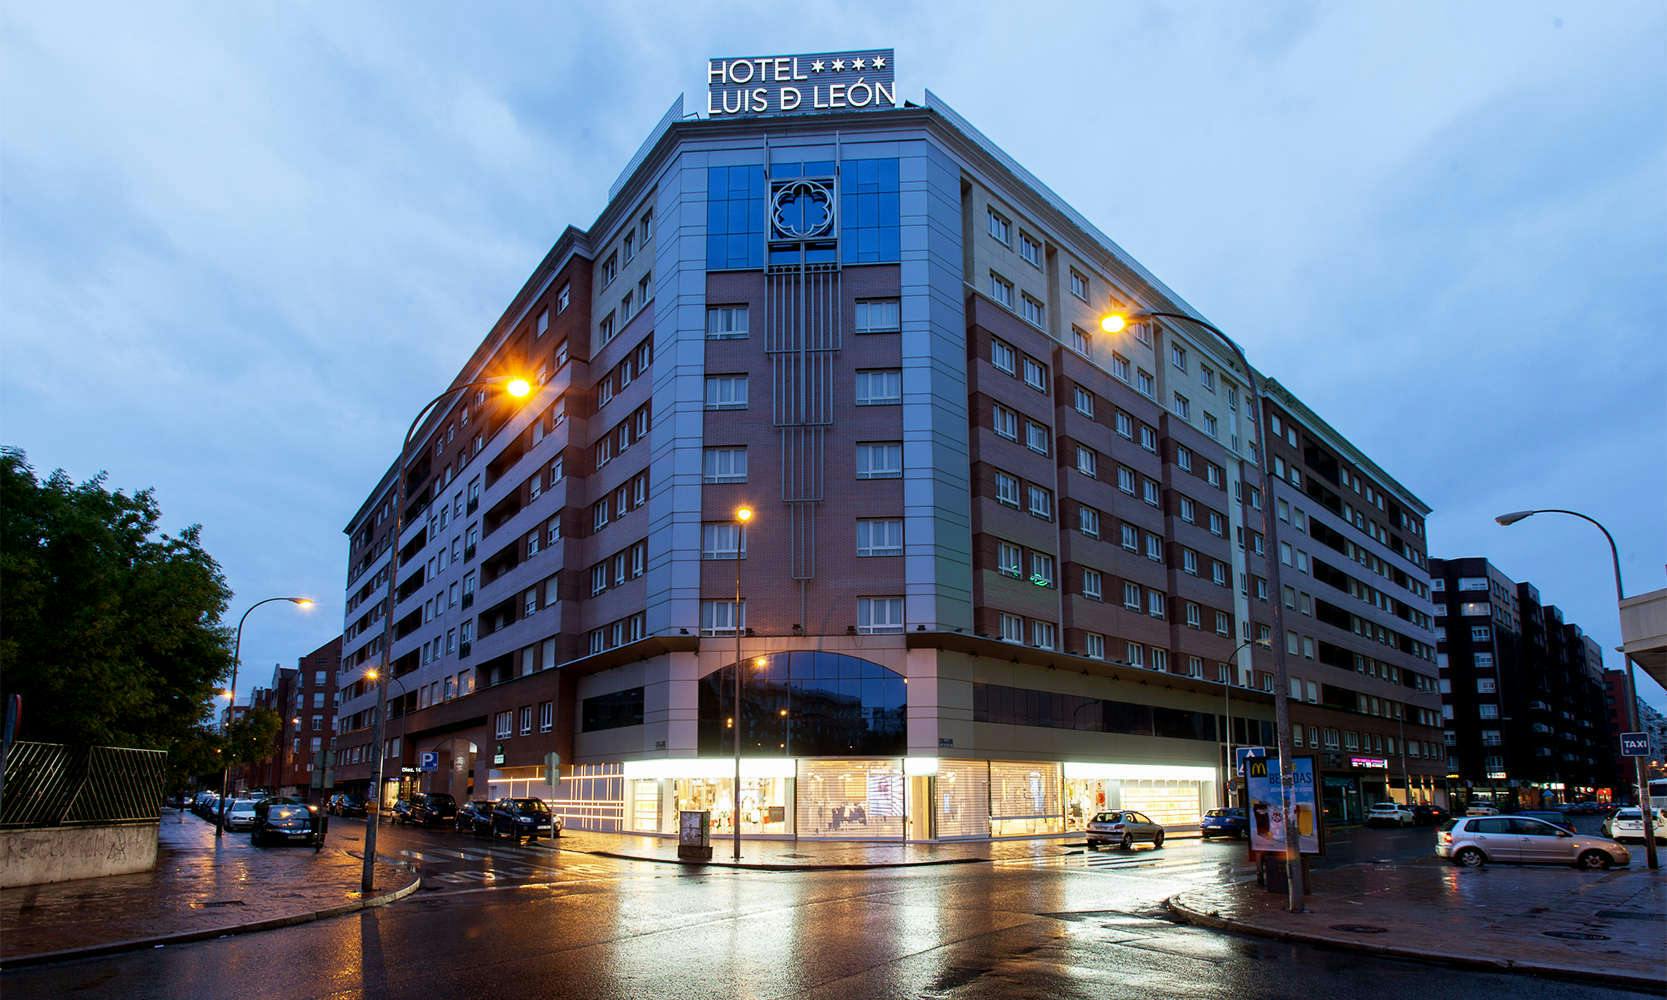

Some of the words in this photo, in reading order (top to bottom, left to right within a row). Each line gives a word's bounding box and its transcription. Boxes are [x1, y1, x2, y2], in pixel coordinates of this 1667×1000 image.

[708, 58, 808, 84] HOTEL
[708, 88, 768, 114] LUIS
[814, 77, 896, 108] LEÓN
[1624, 740, 1647, 748] TAXI
[422, 753, 434, 767] P
[1269, 772, 1312, 785] BEDAS
